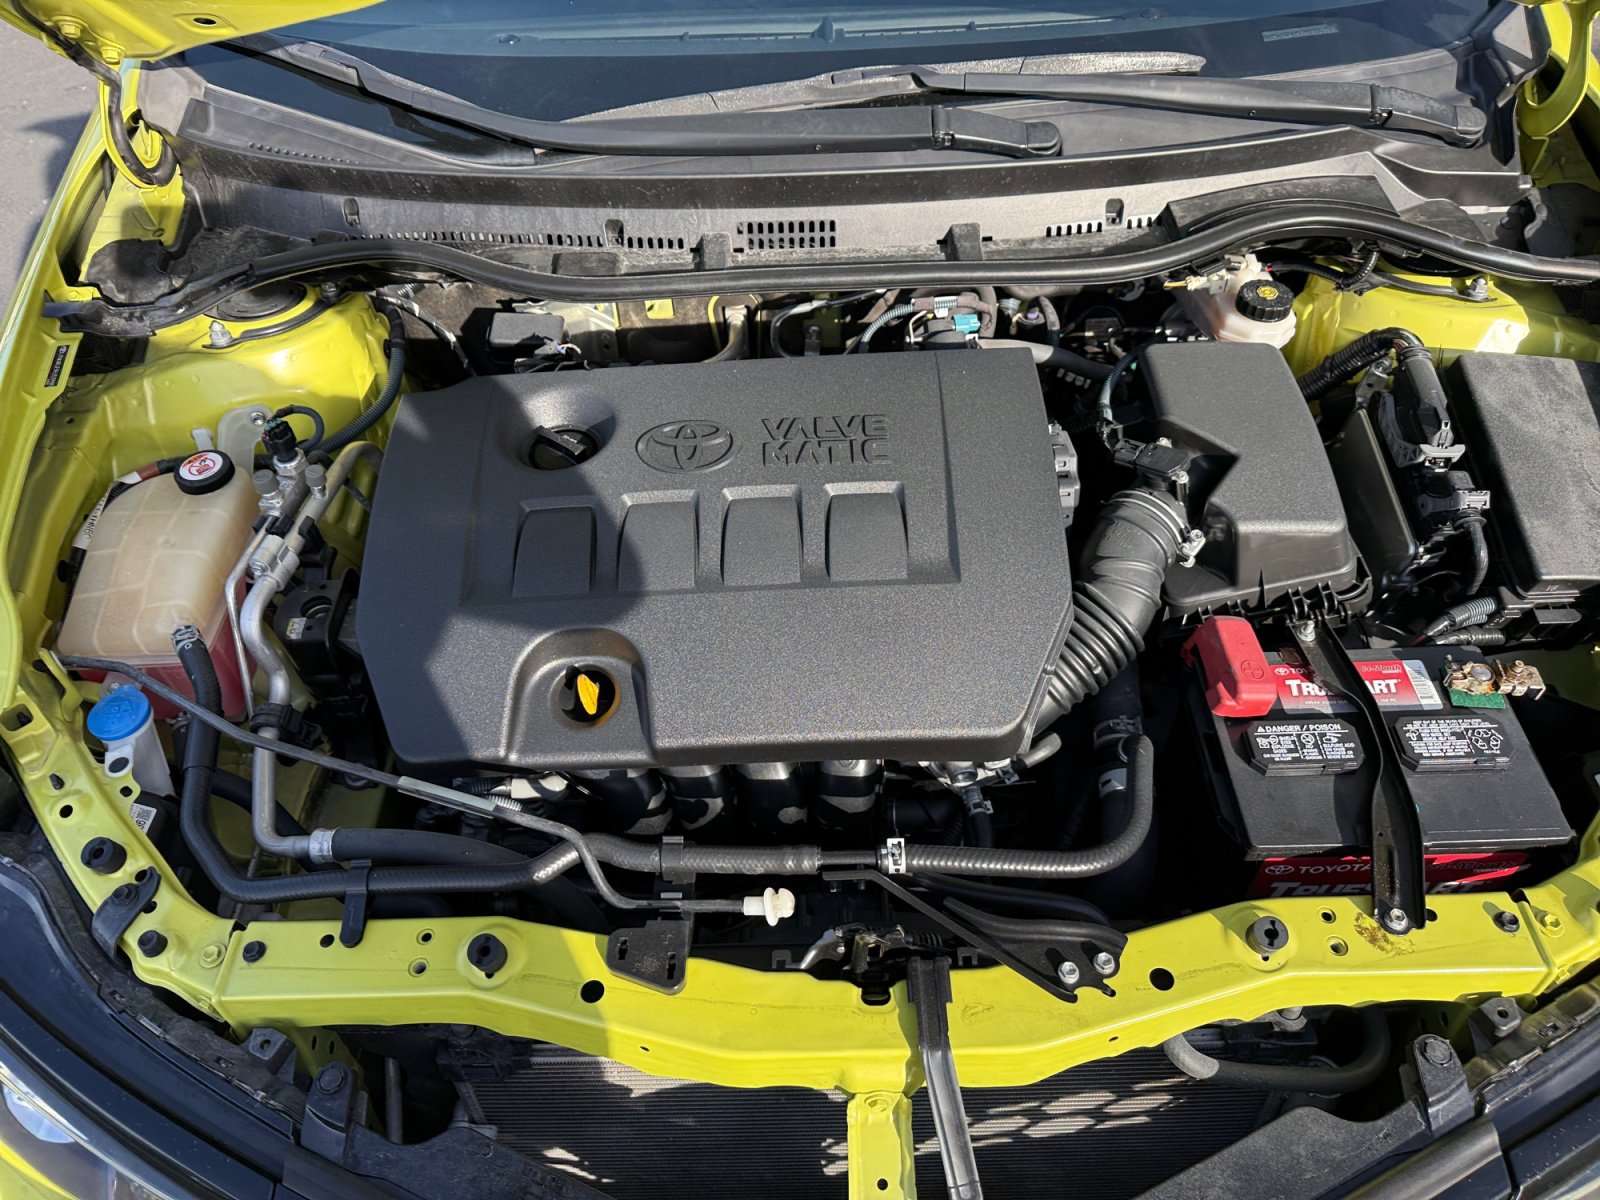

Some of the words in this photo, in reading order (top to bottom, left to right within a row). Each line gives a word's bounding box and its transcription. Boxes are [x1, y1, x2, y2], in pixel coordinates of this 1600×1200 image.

[762, 413, 889, 440] VALVE
[762, 439, 890, 466] MATIC
[1309, 723, 1342, 731] POISON
